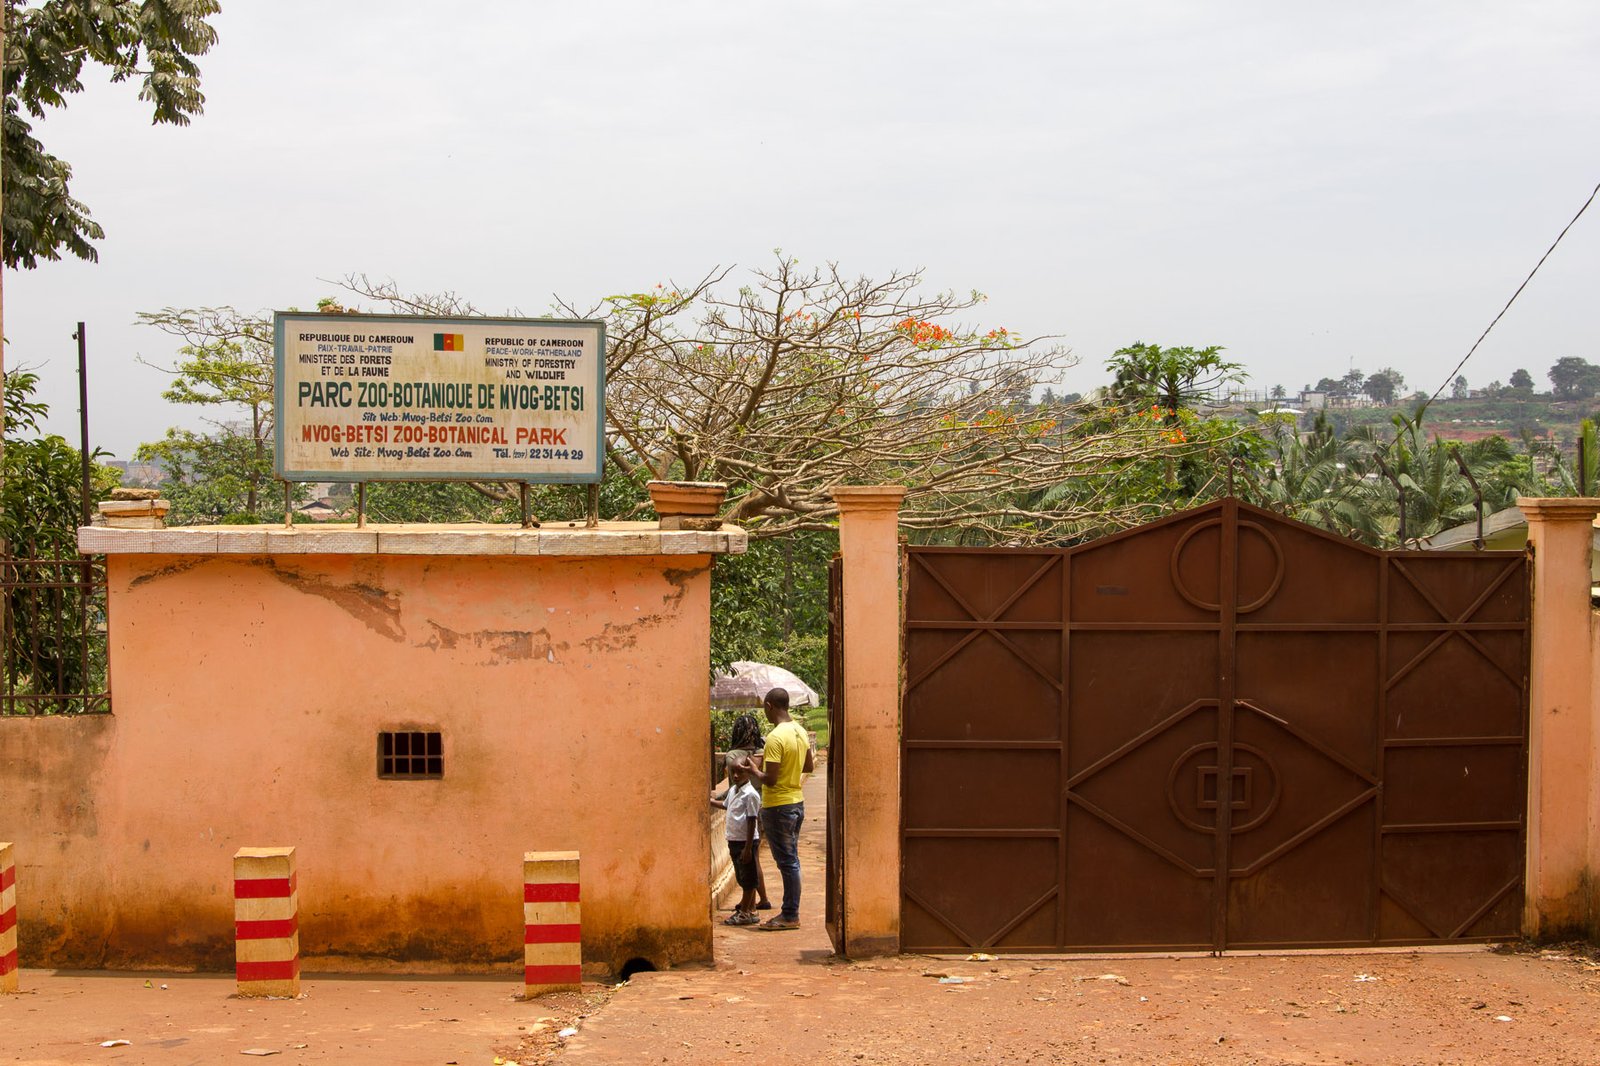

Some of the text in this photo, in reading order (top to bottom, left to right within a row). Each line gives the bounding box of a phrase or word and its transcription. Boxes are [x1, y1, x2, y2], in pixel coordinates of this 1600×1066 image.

[299, 333, 414, 344] REPUBLIQUE DU CAMEROUN
[485, 337, 584, 348] REPUBLIC OF CAMEROON
[317, 344, 393, 353] PAIX-TRAVAIL-PATRIE
[486, 347, 582, 357] PEACE-WORK-FATHERLAND
[299, 354, 392, 365] MINISTERE DES FORETS
[485, 358, 576, 369] MINISTRY OF FORESTRY
[321, 366, 389, 377] ET DE LA FAUNE
[506, 369, 566, 380] AND WILDLIFE
[298, 381, 584, 411] PARC ZOO-BOTANIQUE DE MVOG-BETSI
[362, 412, 376, 422] Site
[302, 424, 567, 445] MVOG-BETSI ZOO-BOTANICAL PARK
[330, 447, 349, 458] Web
